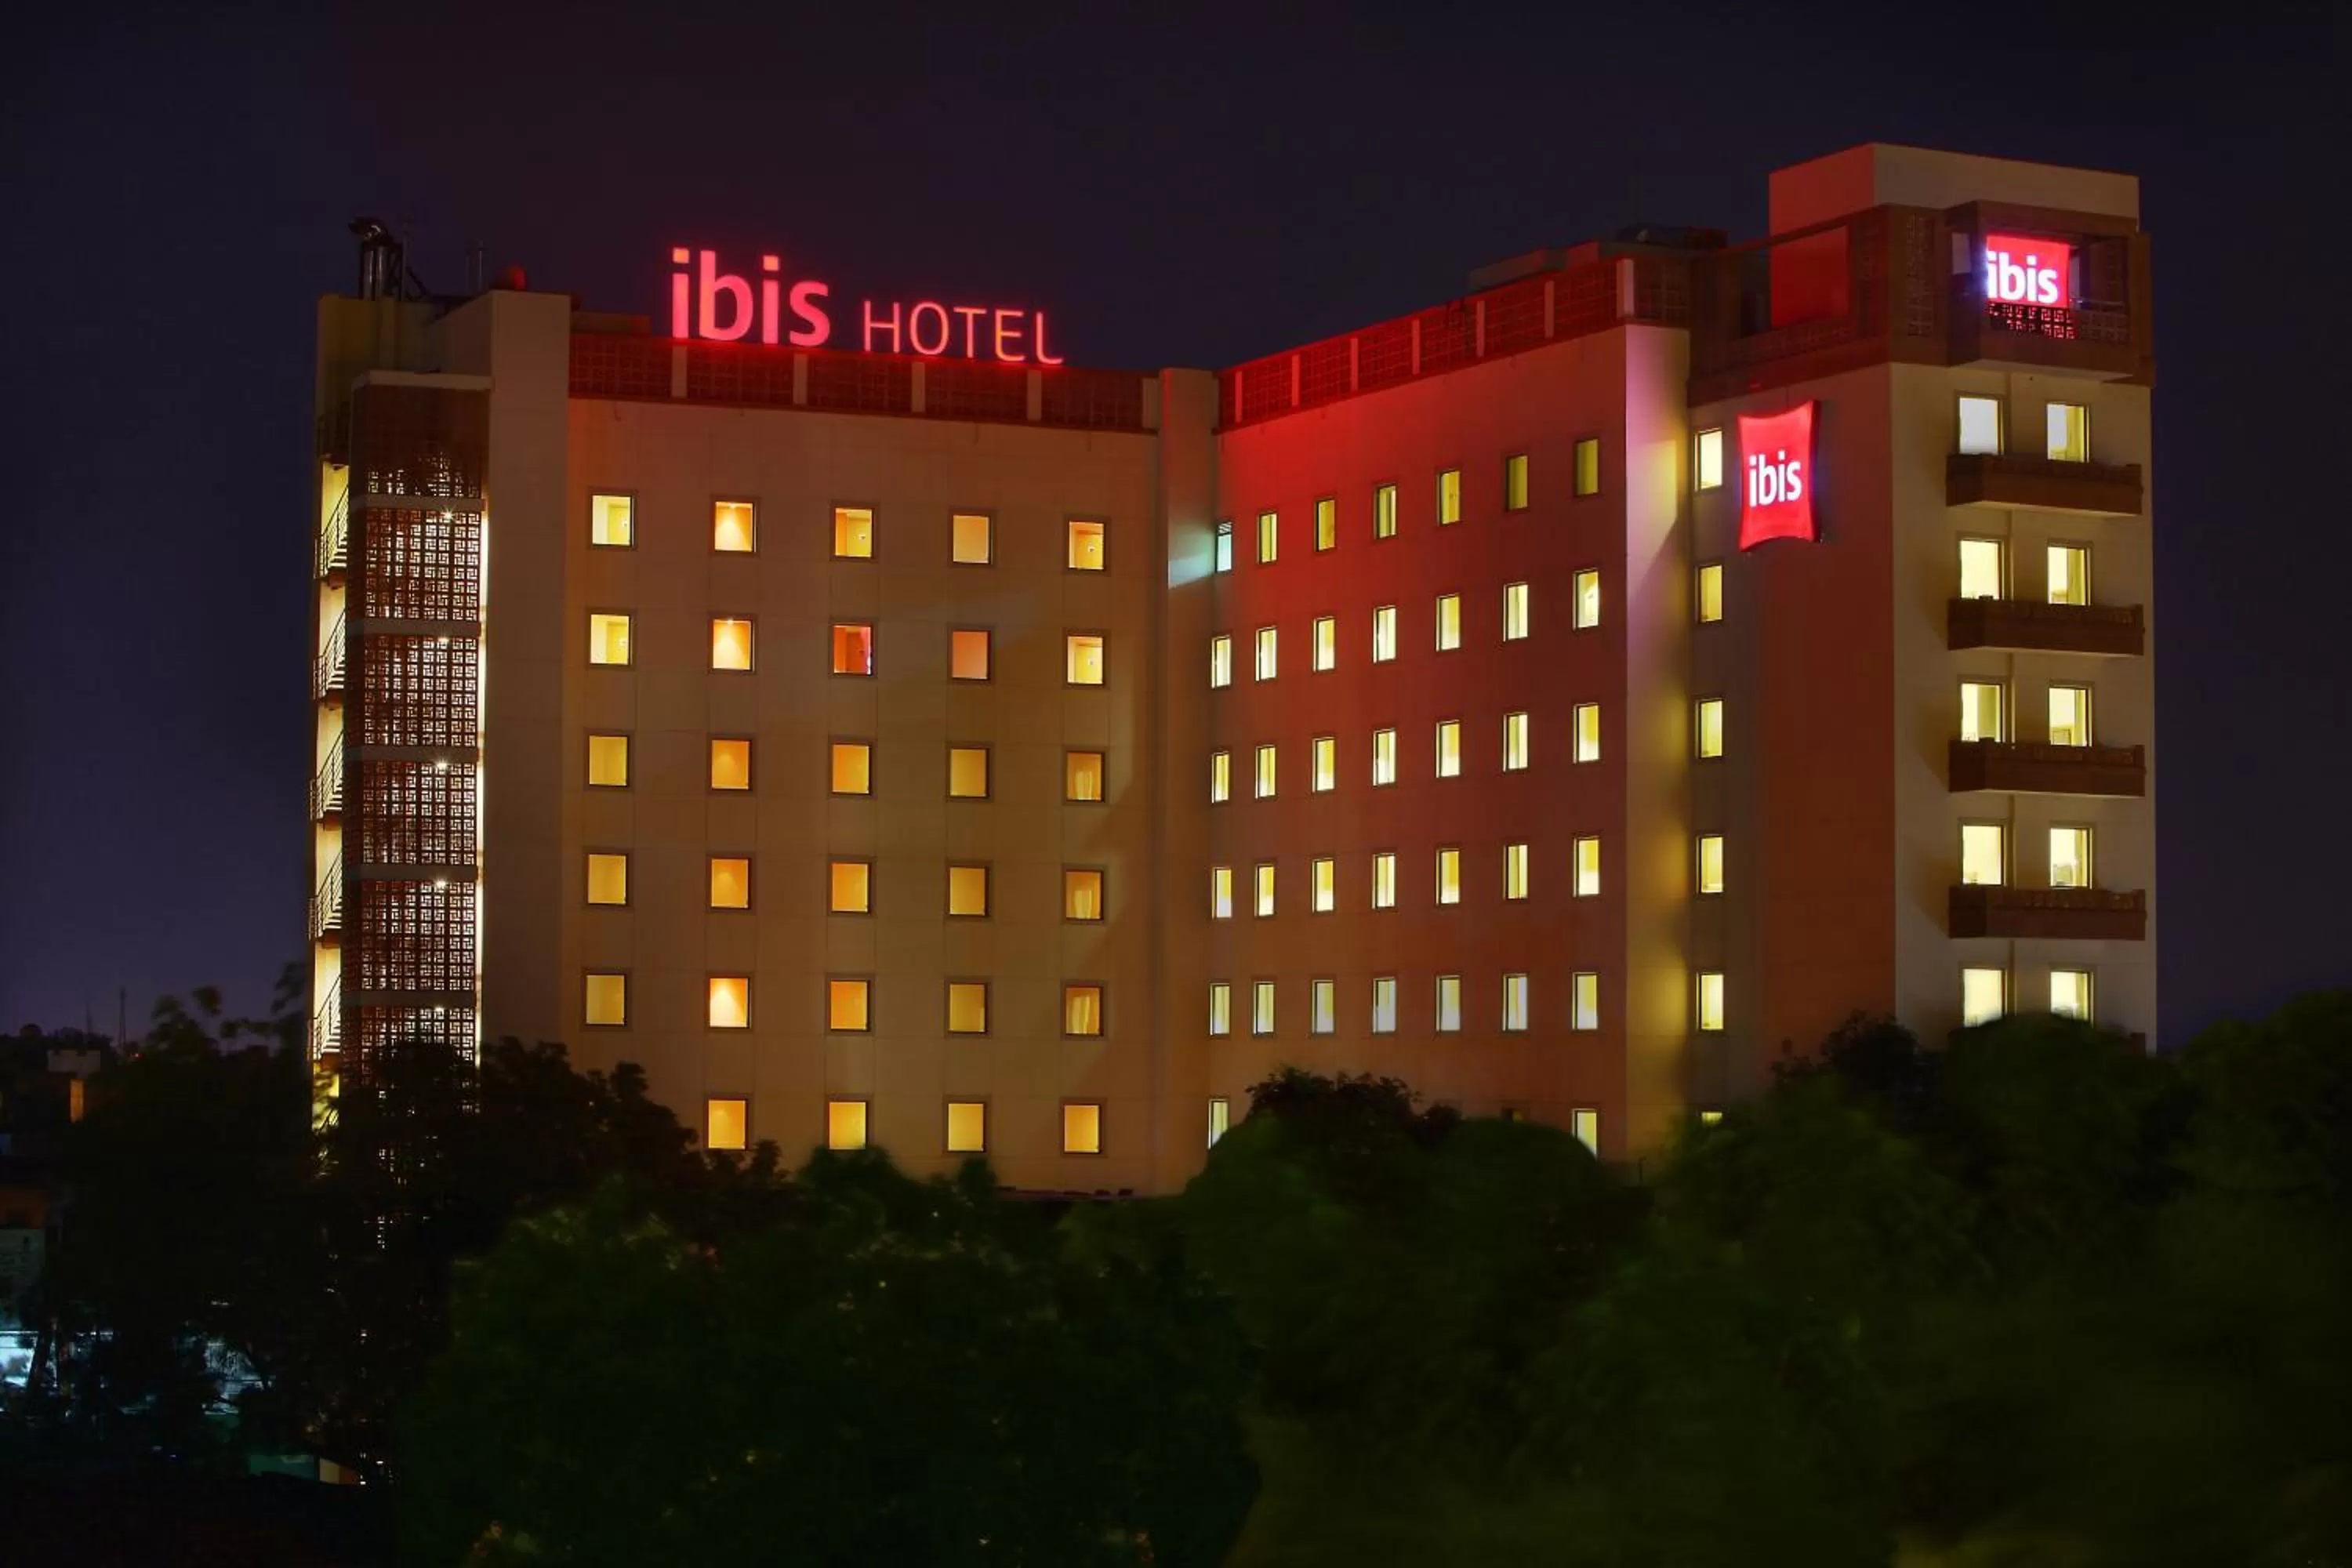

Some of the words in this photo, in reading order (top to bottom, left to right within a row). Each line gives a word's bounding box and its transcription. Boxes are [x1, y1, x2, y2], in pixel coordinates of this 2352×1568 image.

[1987, 250, 2059, 303] ibis
[672, 247, 830, 347] ibis
[863, 299, 1064, 365] HOTEL
[1748, 449, 1802, 507] ibis
